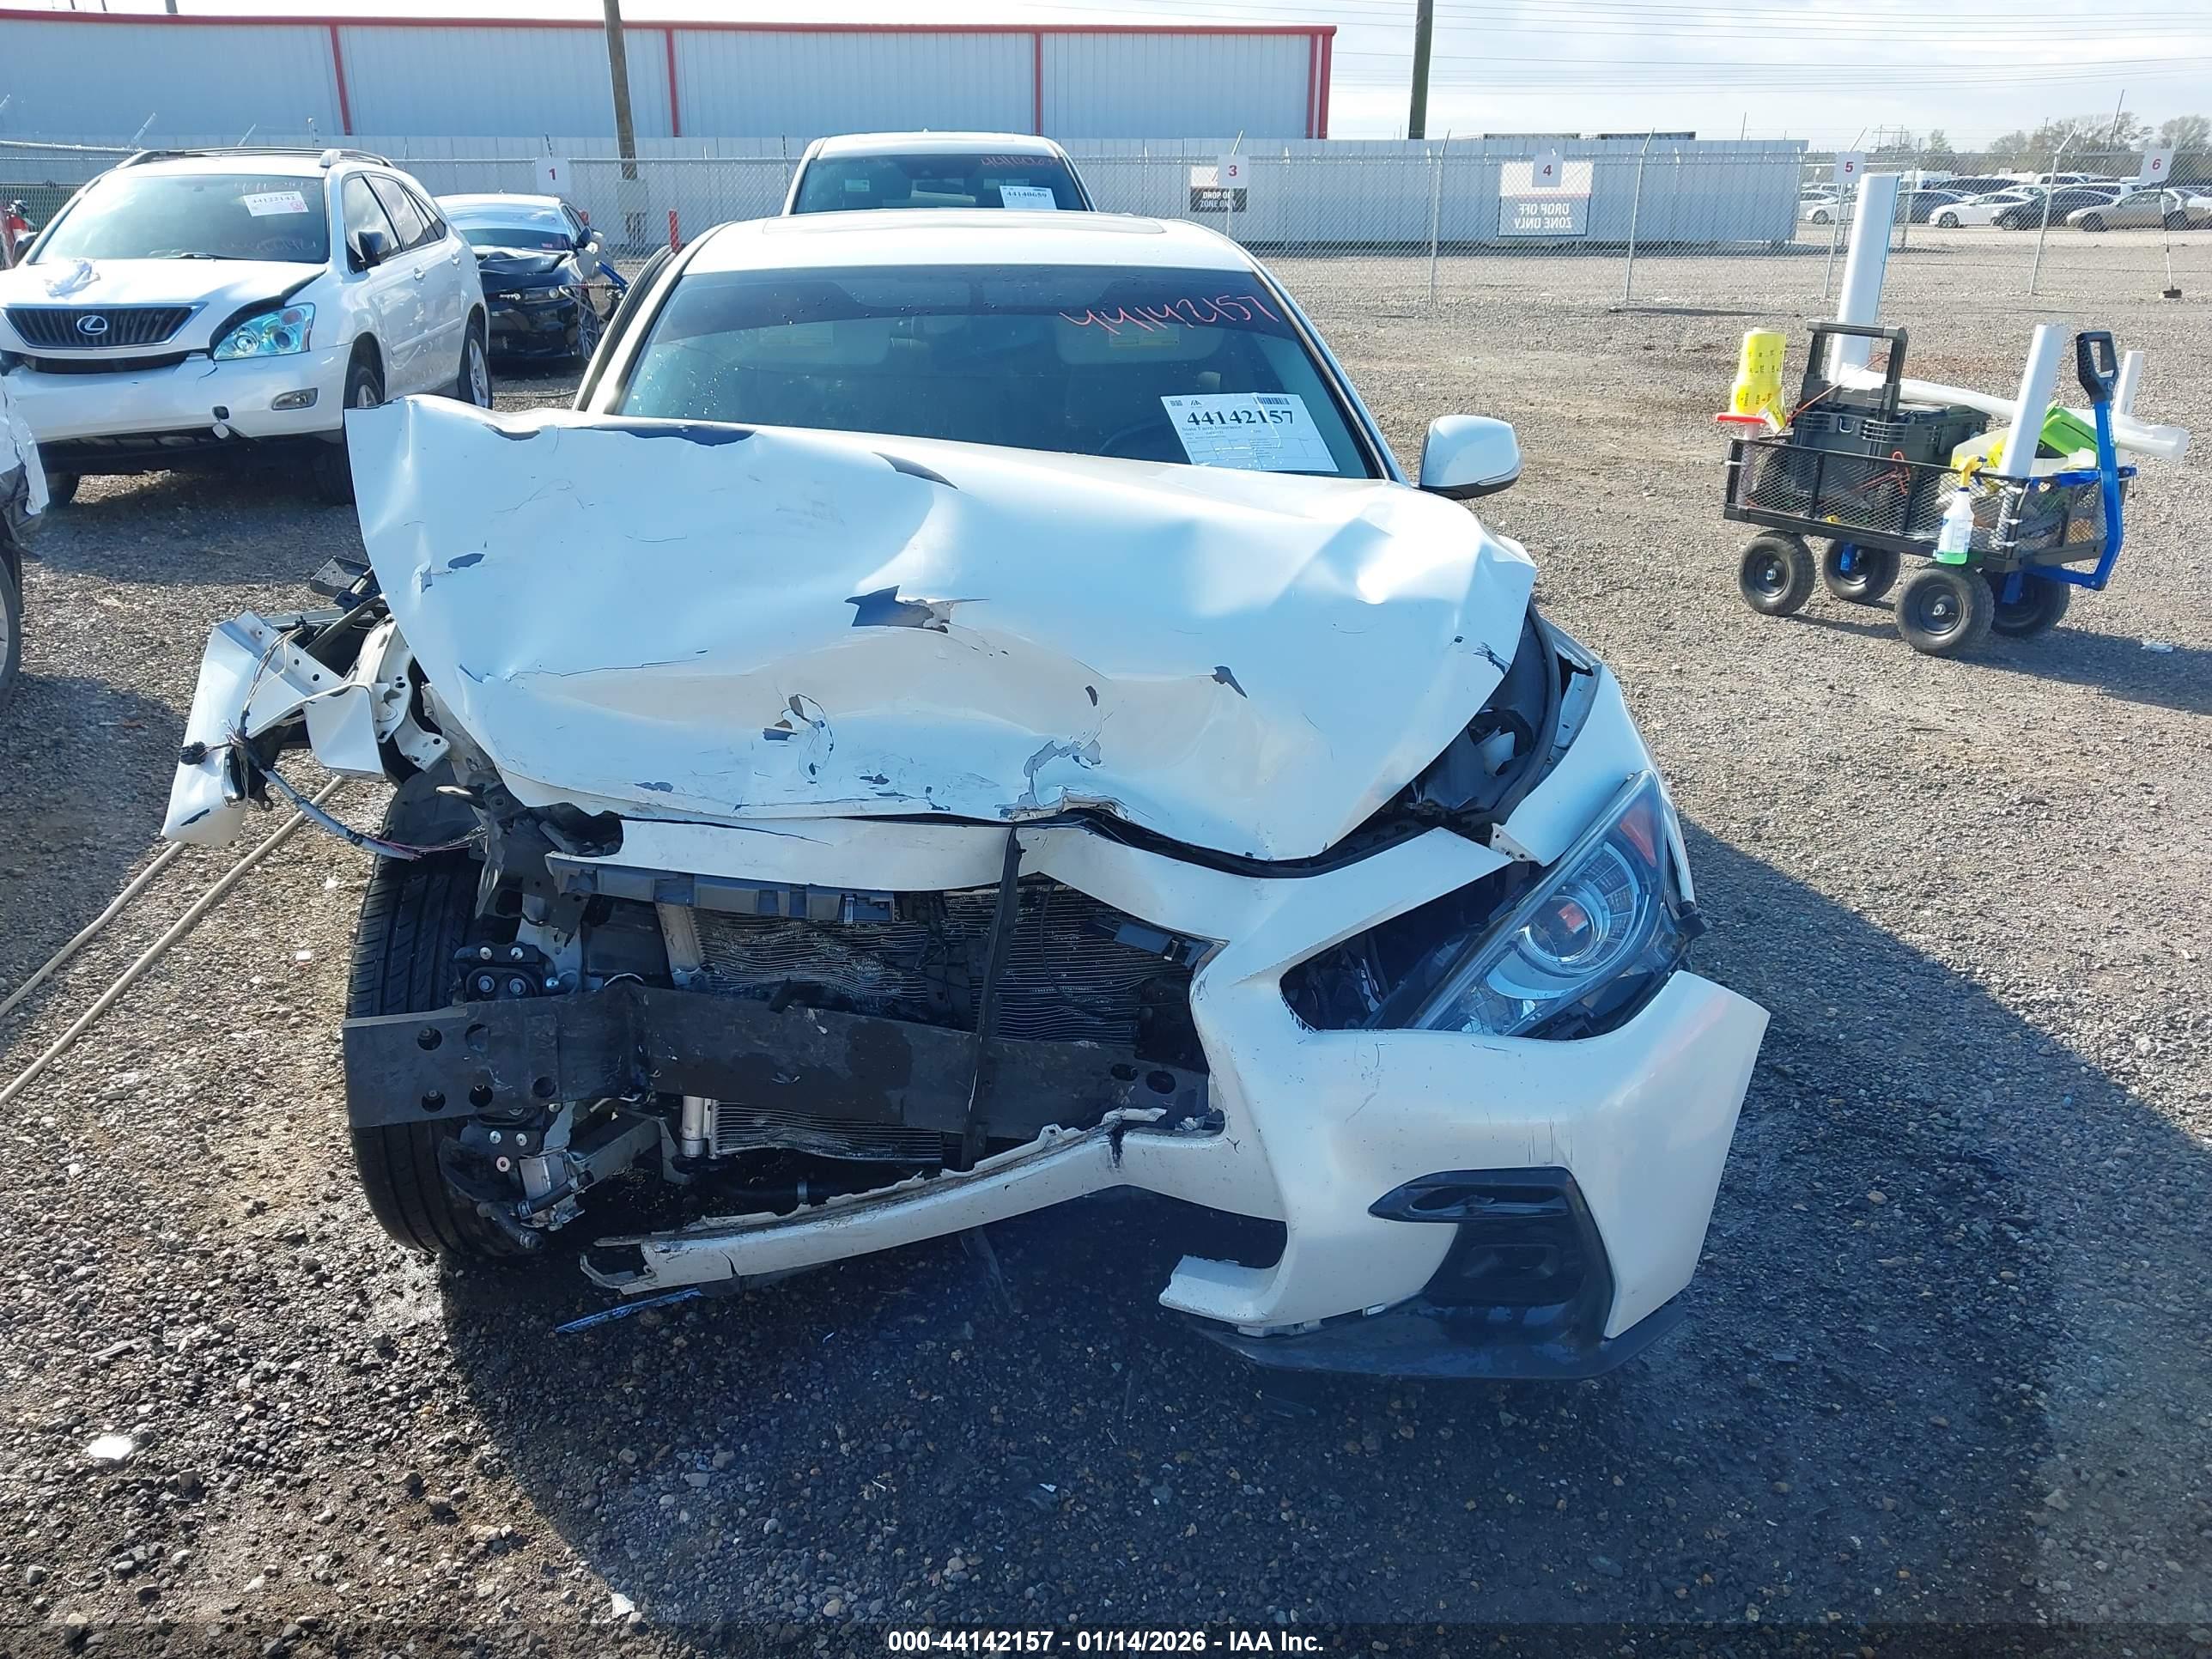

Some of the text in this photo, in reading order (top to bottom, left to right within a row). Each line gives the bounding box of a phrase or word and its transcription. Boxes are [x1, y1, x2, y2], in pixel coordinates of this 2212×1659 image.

[1845, 161, 1854, 173] 5
[2152, 158, 2161, 170] 6
[549, 167, 556, 180] 1
[1228, 165, 1237, 177] 3
[1543, 165, 1553, 176] 4
[1059, 295, 1279, 336] 44142157
[1187, 410, 1293, 426] 44142157
